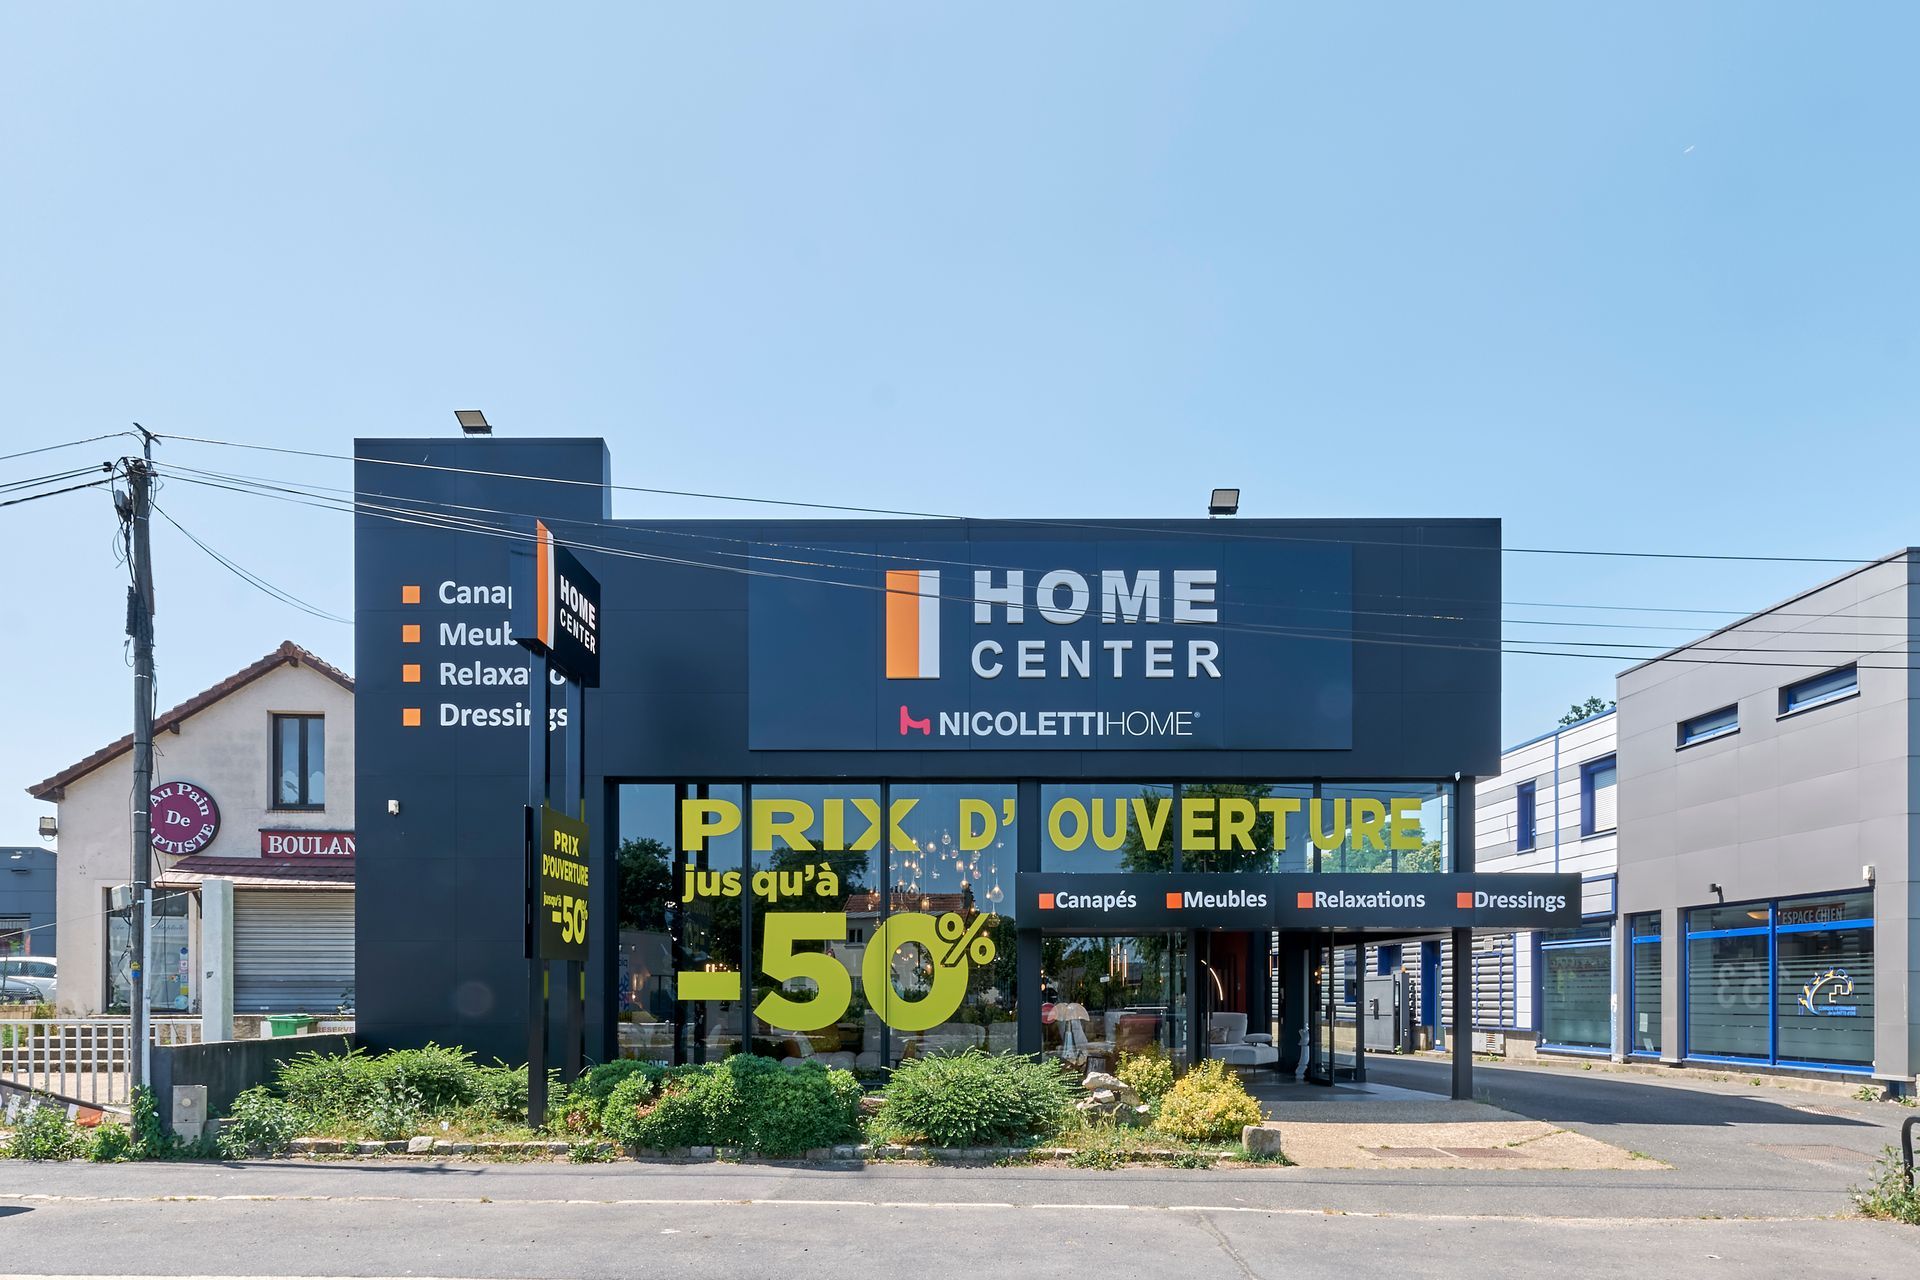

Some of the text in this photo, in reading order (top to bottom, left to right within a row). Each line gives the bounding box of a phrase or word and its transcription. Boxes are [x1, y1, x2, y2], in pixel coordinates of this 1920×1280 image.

[560, 574, 596, 631] HOME
[974, 569, 1218, 625] HOME
[560, 608, 596, 655] CENTER
[971, 639, 1222, 679] CENTER
[150, 783, 210, 816] Au Pain
[165, 810, 191, 827] De
[150, 815, 215, 854] PTISTE
[554, 830, 580, 857] PRIX
[682, 798, 920, 851] PRIX
[1047, 797, 1424, 852] OUVERTURE
[542, 854, 589, 887] D'OUVERTURE
[1055, 889, 1566, 913] Canapés Meubles Relaxations Dressings
[1782, 907, 1843, 925] ESPACE CHIEN
[677, 911, 996, 1031] -50%
